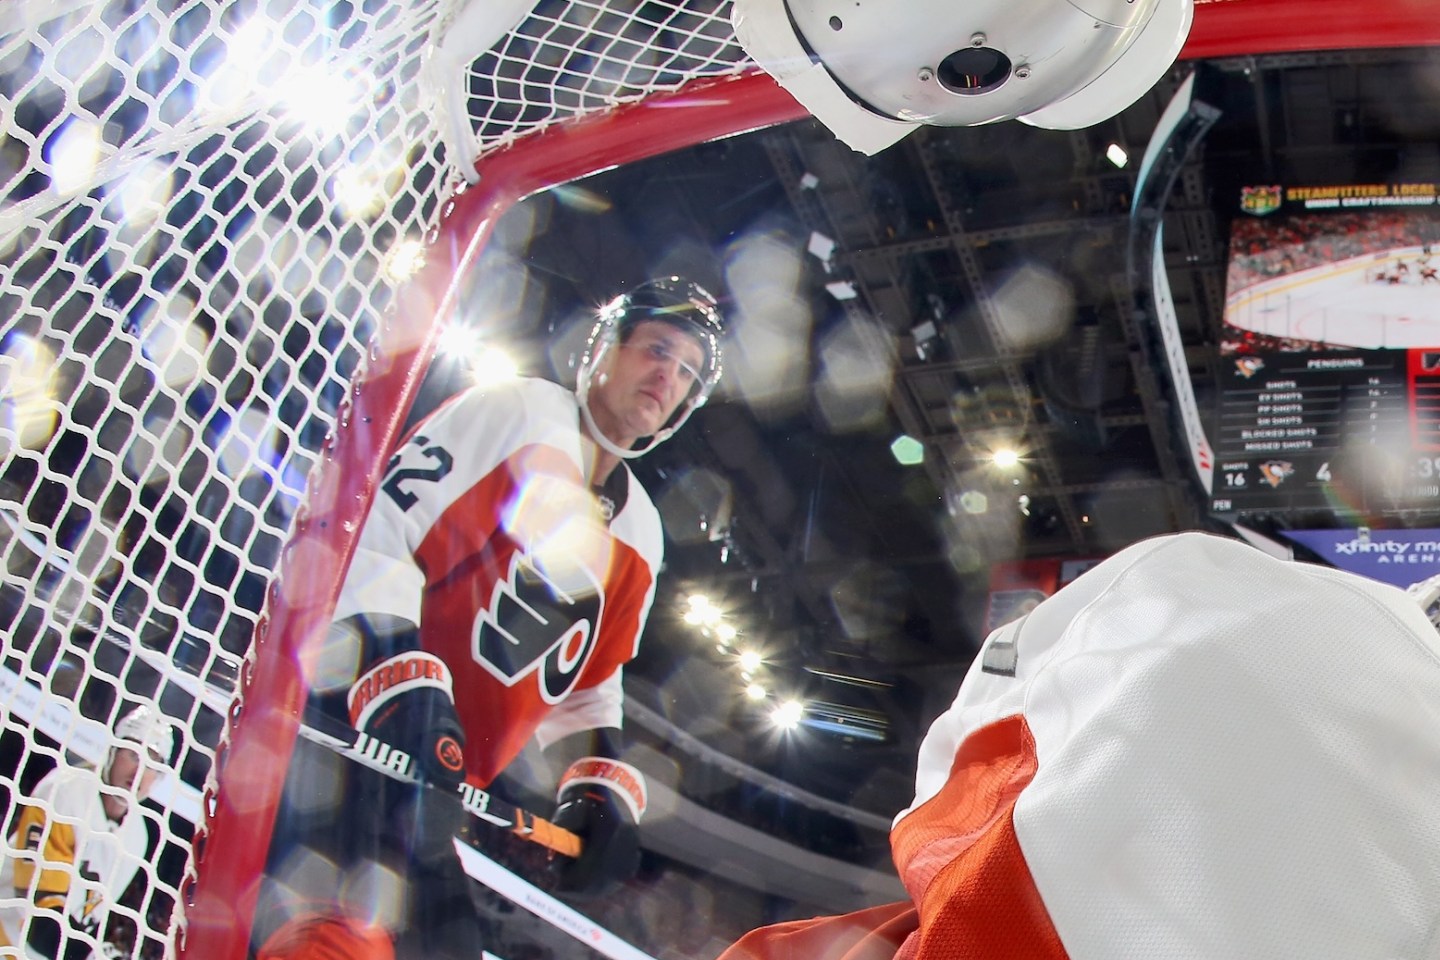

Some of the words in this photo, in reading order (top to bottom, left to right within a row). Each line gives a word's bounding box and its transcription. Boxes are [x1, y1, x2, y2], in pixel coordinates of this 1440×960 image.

[1392, 183, 1437, 197] LOCAL
[1307, 358, 1364, 369] PENGUINS
[1265, 380, 1297, 389] SHOTS
[1225, 473, 1246, 487] 16
[1335, 540, 1411, 555] xfinity
